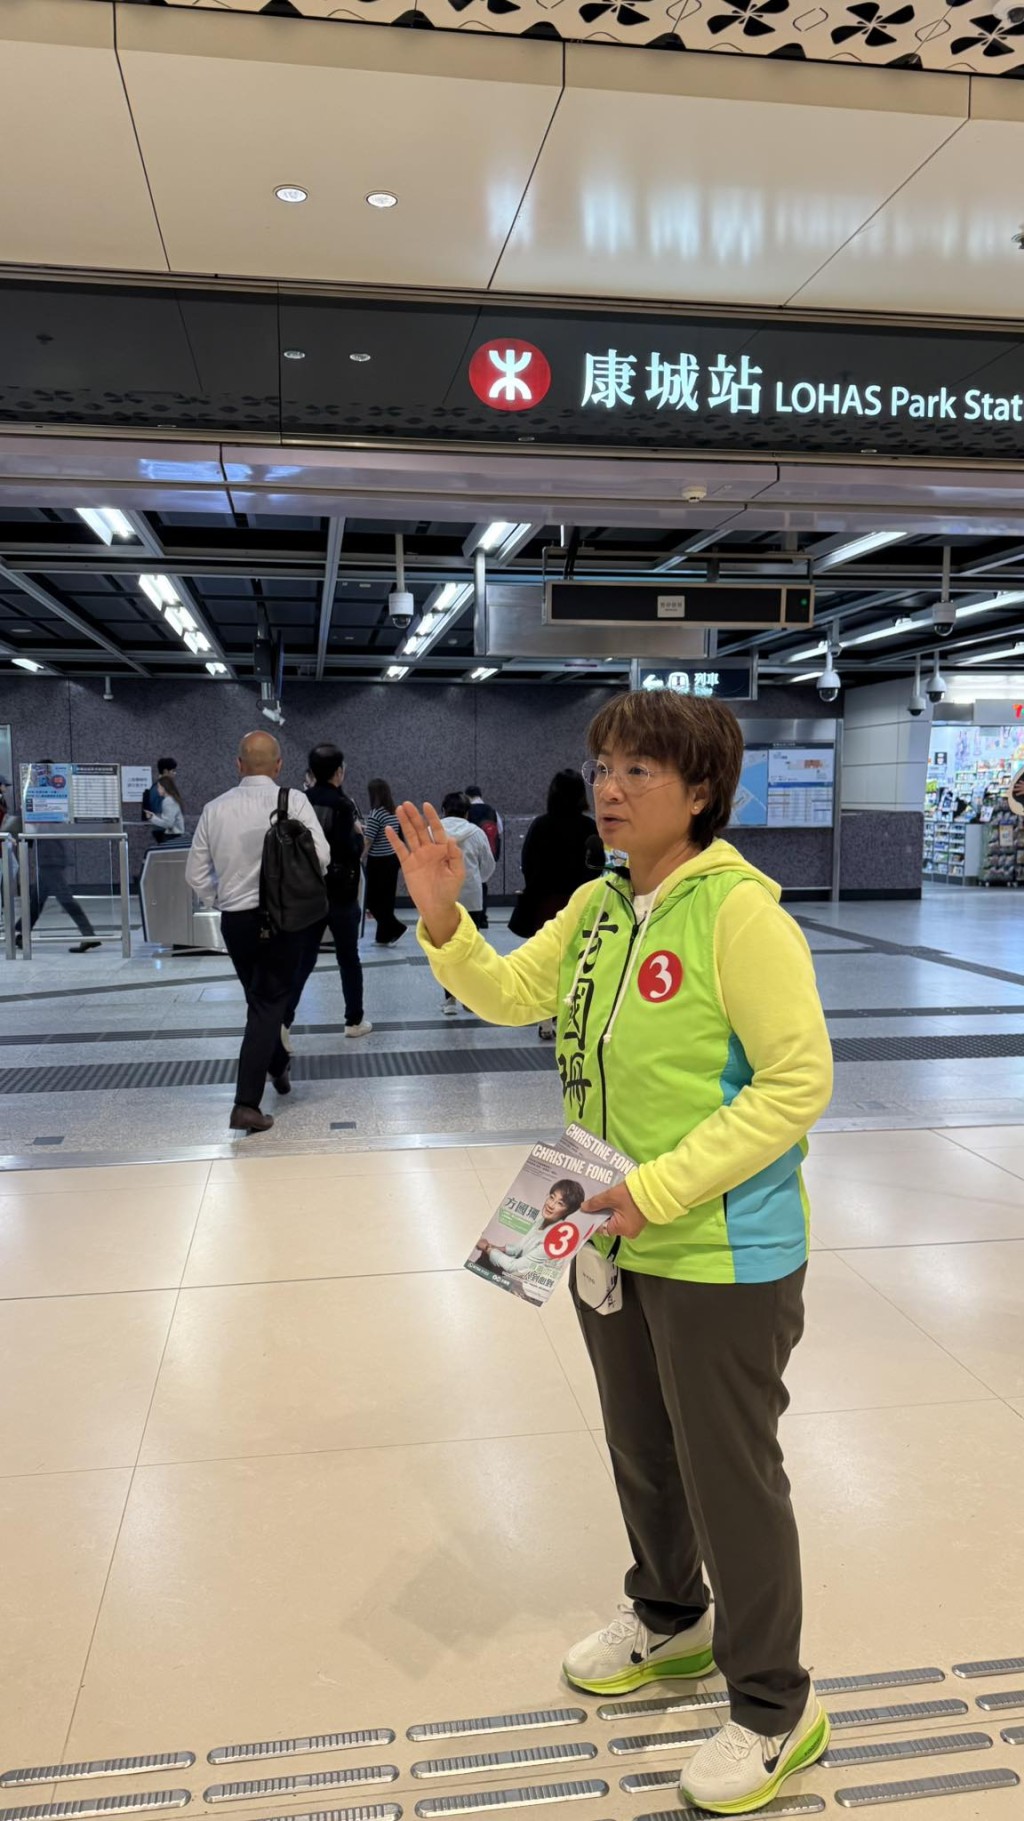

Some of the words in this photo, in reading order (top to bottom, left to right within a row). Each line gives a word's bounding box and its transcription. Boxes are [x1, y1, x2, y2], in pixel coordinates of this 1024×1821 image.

[580, 348, 763, 415] 康城站
[775, 381, 882, 416] LOHAS
[890, 386, 957, 419] Park
[963, 388, 1024, 422] Stat
[649, 954, 673, 999] 3
[565, 1123, 613, 1161] CHRISTINE
[531, 1144, 586, 1175] CHRISTINE
[584, 1162, 614, 1185] FONG
[548, 1224, 574, 1256] 3
